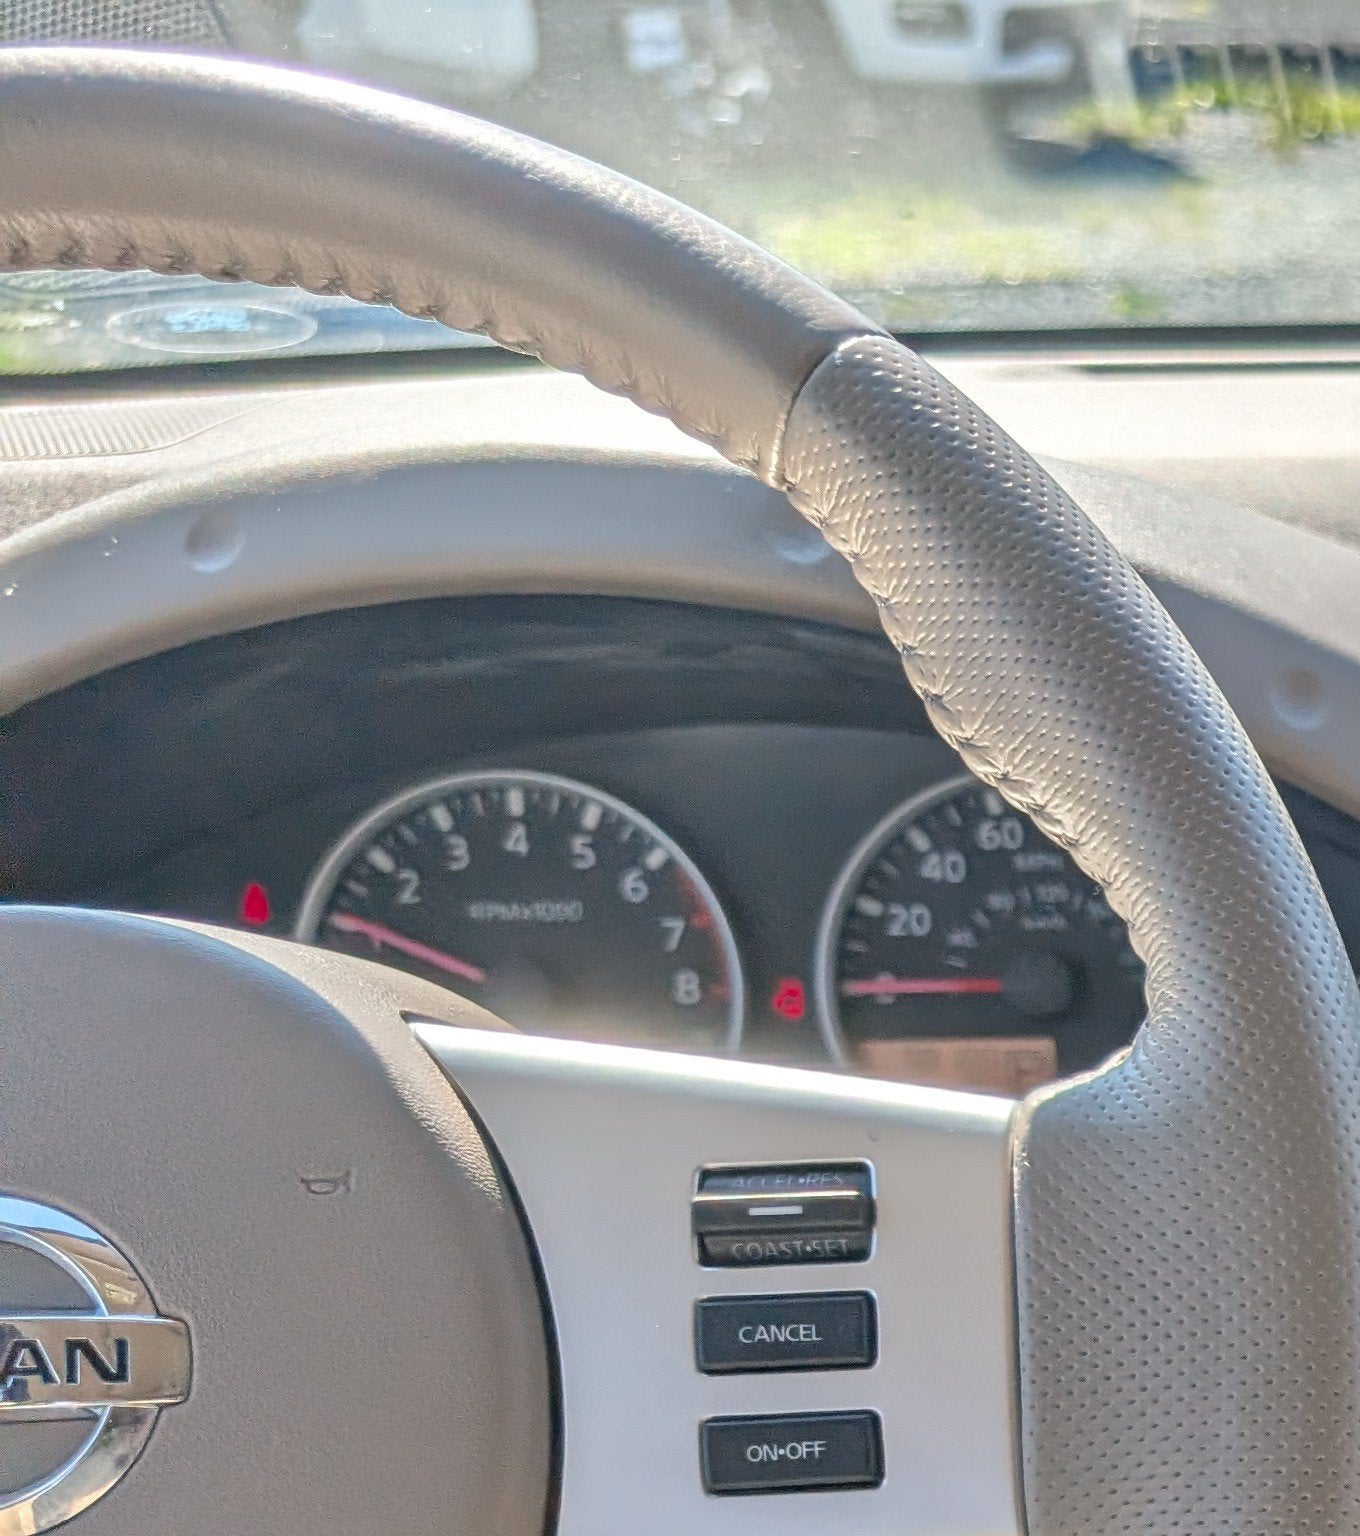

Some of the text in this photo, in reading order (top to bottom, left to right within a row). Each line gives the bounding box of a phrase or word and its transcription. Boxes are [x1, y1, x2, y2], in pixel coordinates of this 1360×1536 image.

[504, 823, 529, 857] 4
[571, 833, 596, 870] 5
[977, 818, 1025, 851] 60
[447, 835, 470, 871] 3
[920, 851, 967, 883] 40
[399, 869, 421, 904] 2
[621, 868, 649, 903] 6
[658, 917, 685, 951] 7
[887, 902, 932, 937] 20
[673, 969, 701, 1005] 8
[738, 1322, 822, 1344] CANCEL
